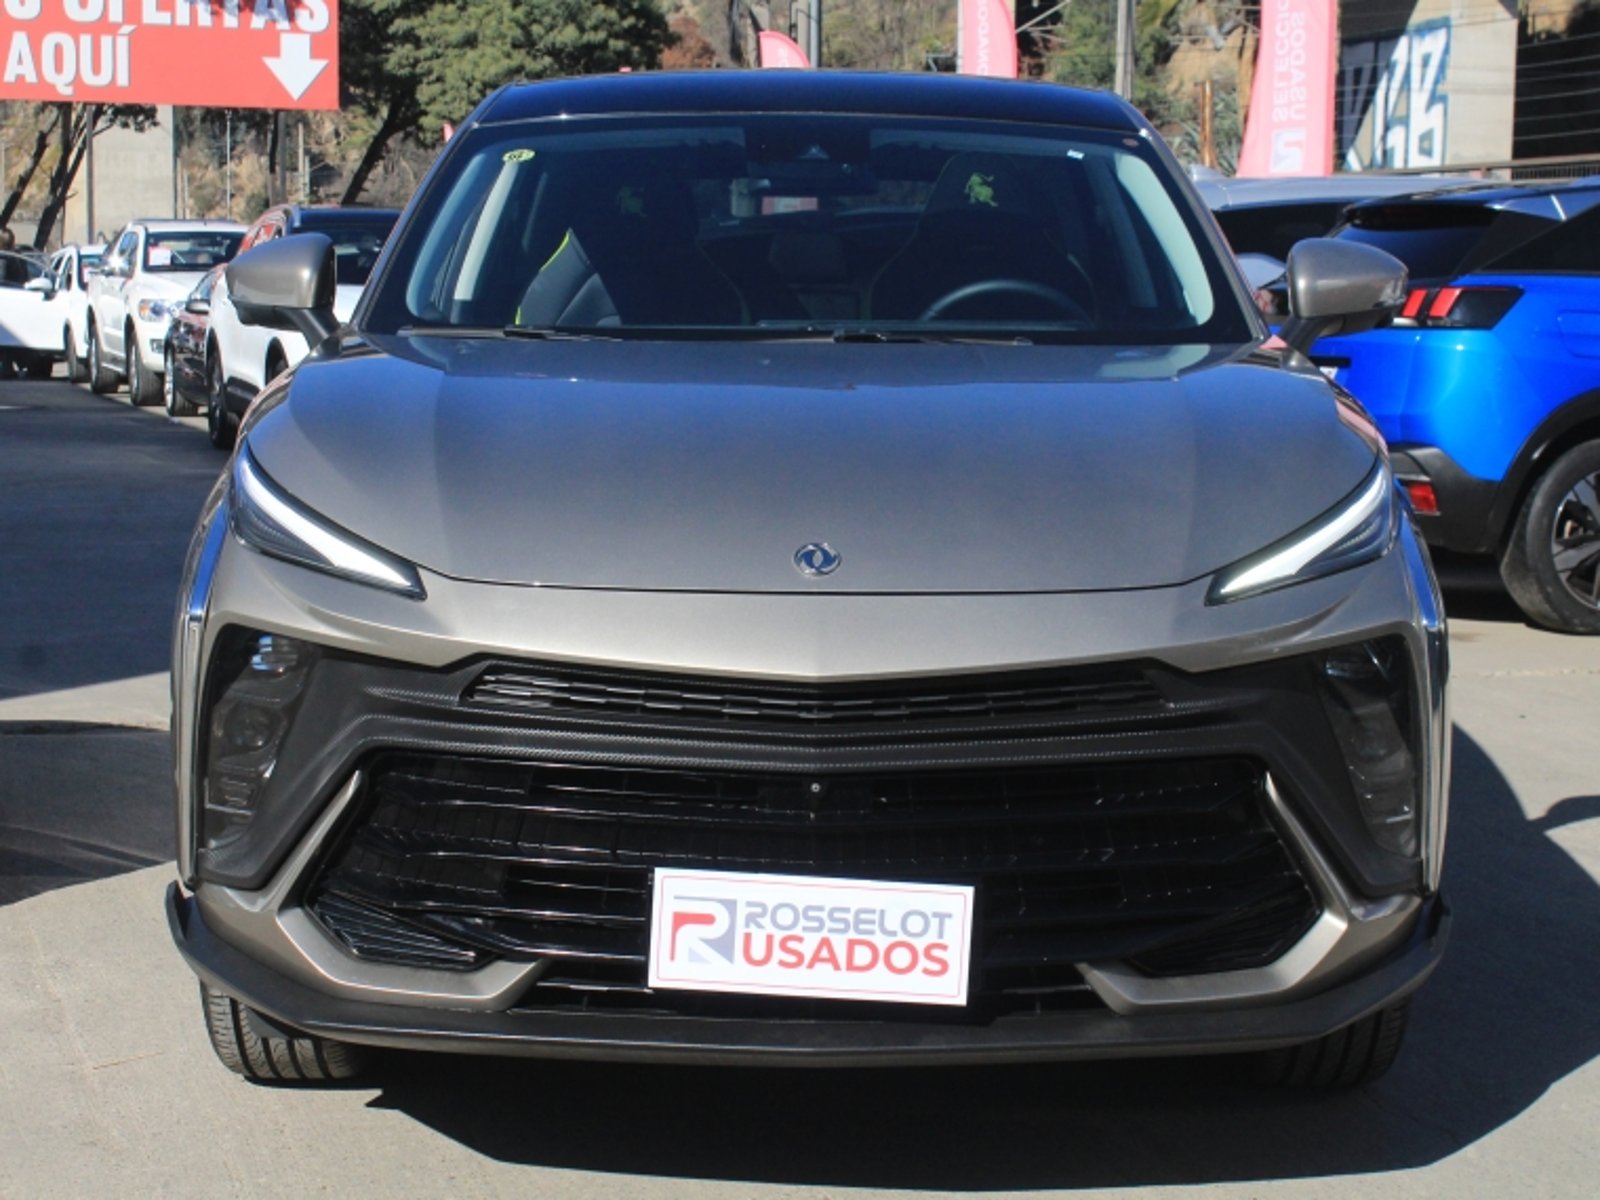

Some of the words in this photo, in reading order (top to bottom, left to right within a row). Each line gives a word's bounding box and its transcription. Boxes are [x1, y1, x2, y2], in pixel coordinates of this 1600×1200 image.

[3, 25, 138, 96] AQUÍ
[743, 900, 953, 940] ROSSELOT
[742, 932, 951, 978] USADOS
